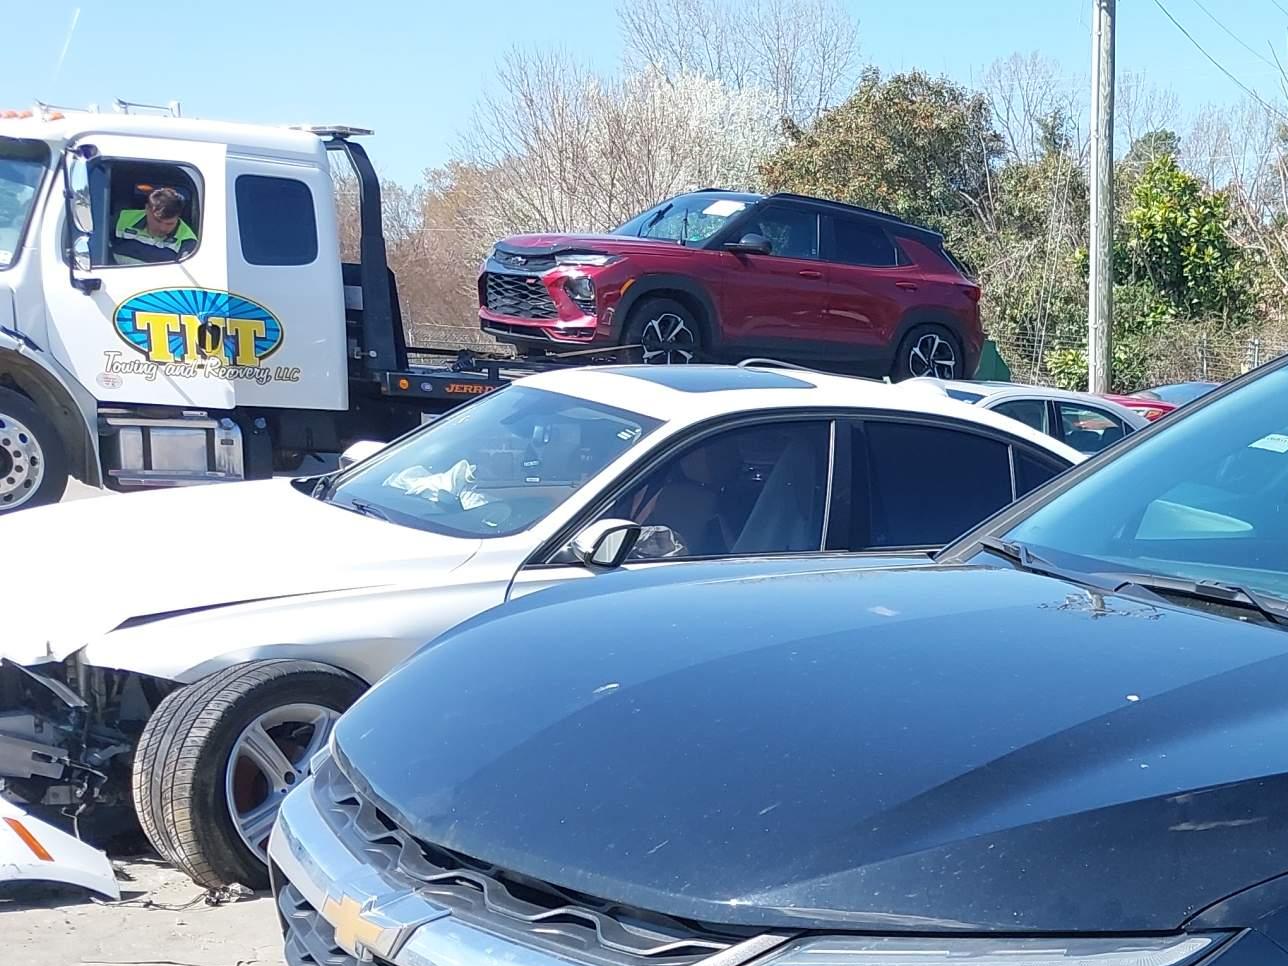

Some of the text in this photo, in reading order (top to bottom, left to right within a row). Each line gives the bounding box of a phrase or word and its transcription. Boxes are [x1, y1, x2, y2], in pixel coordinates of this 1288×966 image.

[133, 311, 267, 367] TNT
[103, 350, 158, 381] Towing
[165, 359, 198, 378] and
[274, 366, 301, 382] LLC
